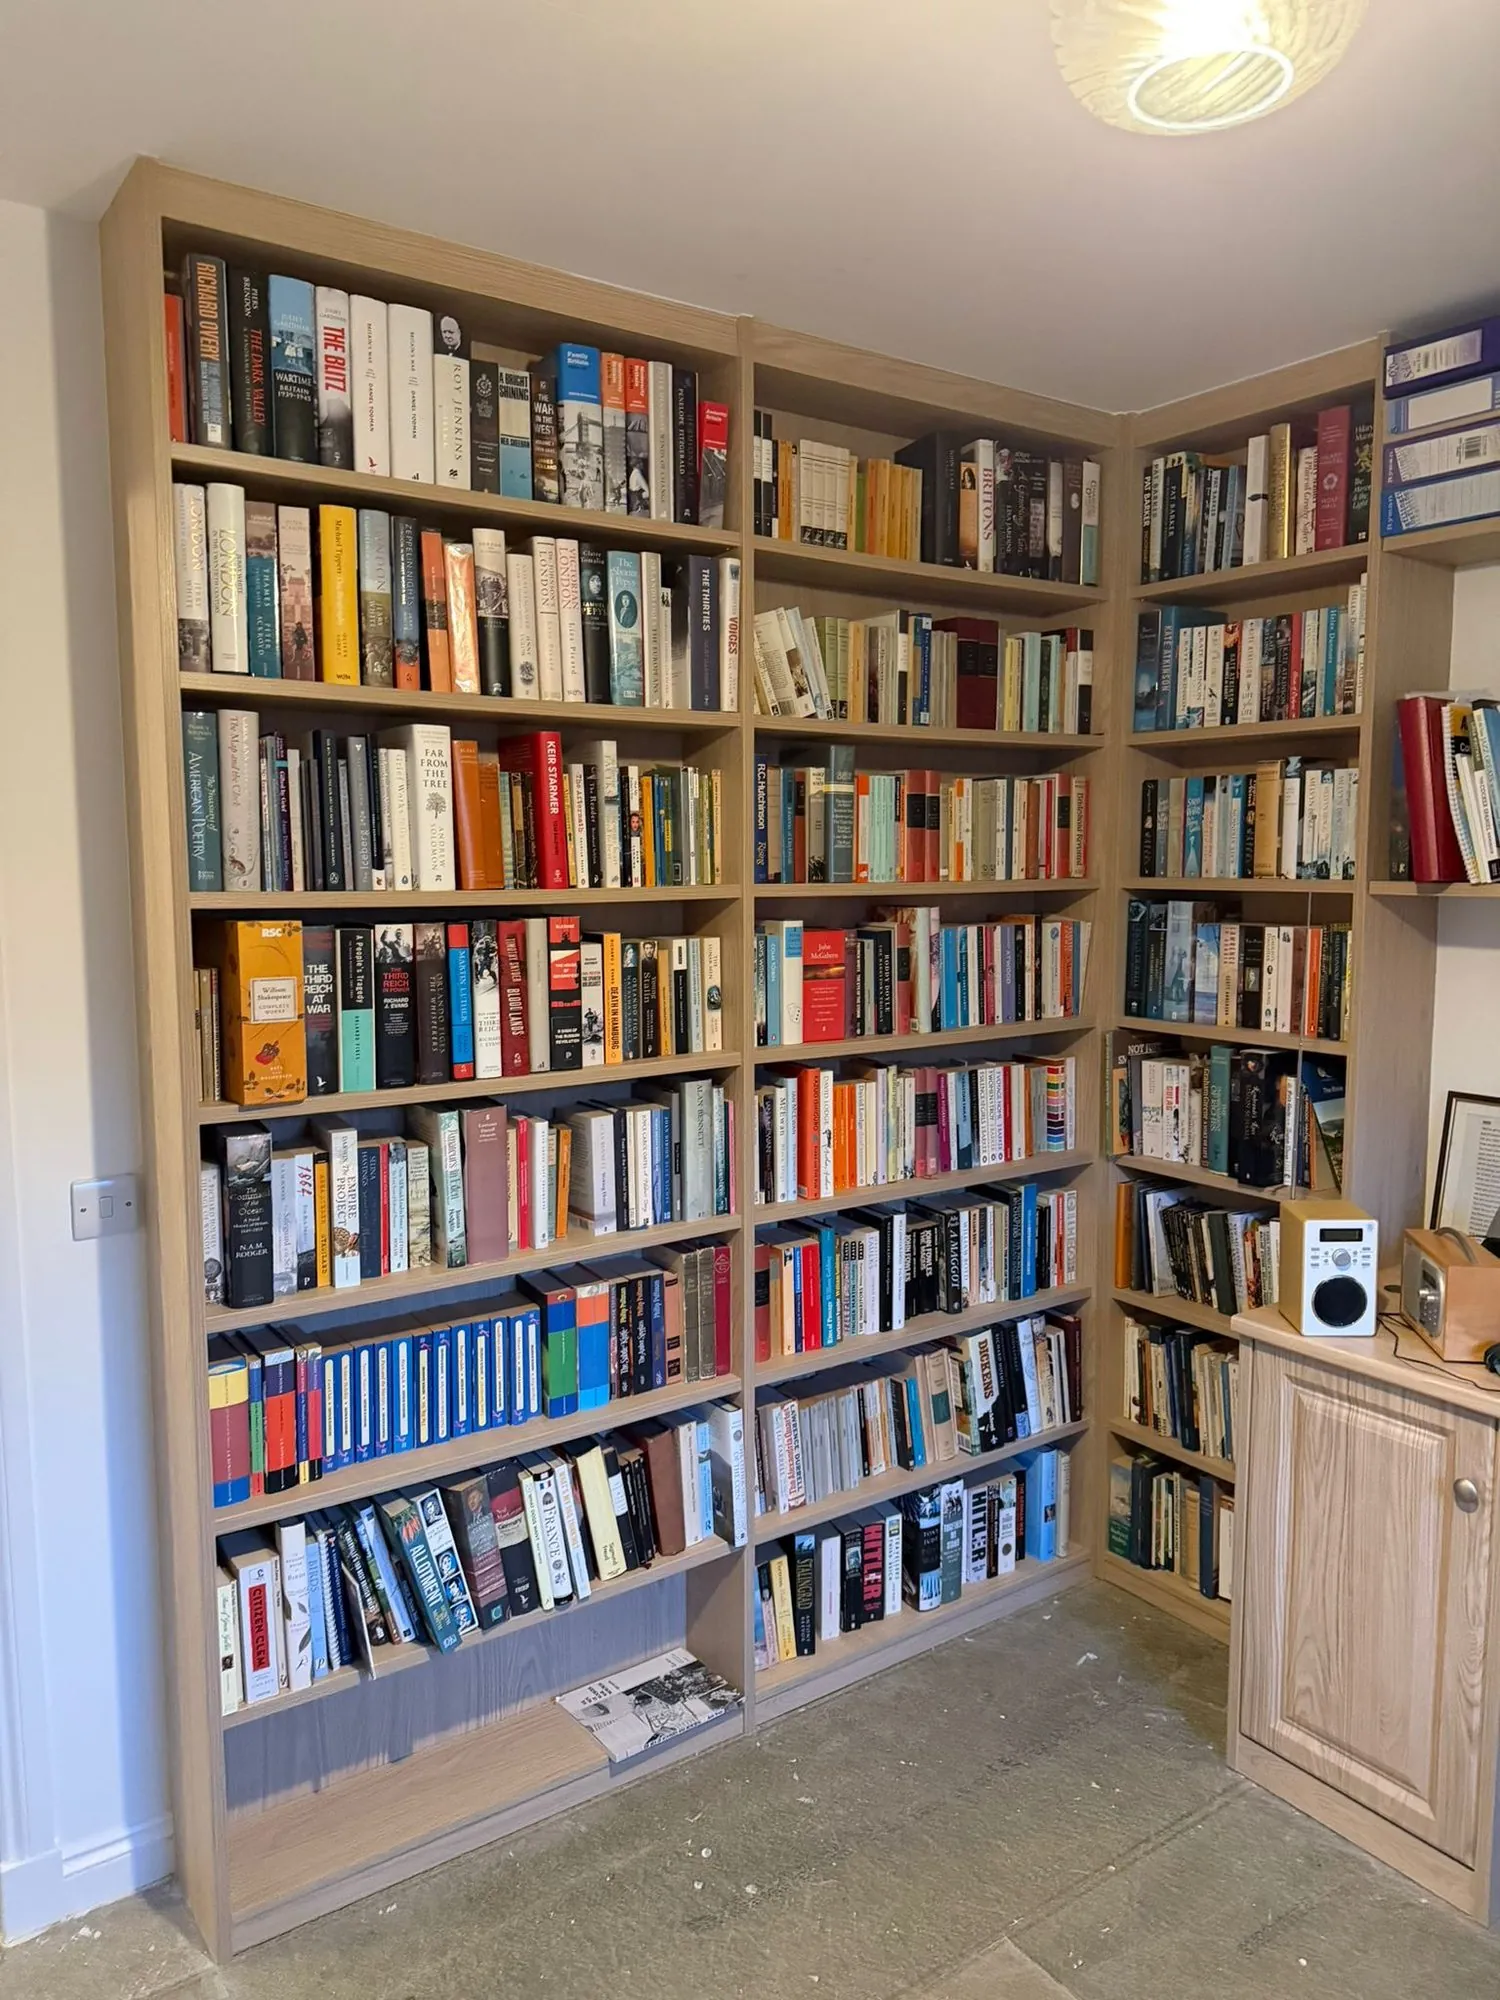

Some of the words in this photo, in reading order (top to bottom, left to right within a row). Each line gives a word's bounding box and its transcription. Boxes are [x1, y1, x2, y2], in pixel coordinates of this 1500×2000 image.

[197, 262, 218, 318] RICHARD
[199, 320, 220, 362] OVERY
[251, 329, 263, 350] THE
[323, 325, 345, 354] THE
[251, 352, 263, 384] DARK
[275, 371, 312, 387] WARTIME
[324, 355, 347, 393] BLITZ
[453, 364, 462, 395] ROY
[506, 373, 529, 388] BRIGHT
[253, 386, 265, 425] VALLEY
[499, 385, 529, 400] SHINING
[534, 402, 554, 415] WAR
[453, 397, 462, 462] JENKINS
[1142, 476, 1151, 491] PAT
[983, 467, 992, 540] BRITONS
[1142, 493, 1151, 527] BARKER
[405, 524, 413, 569] ZEPPELIN
[219, 529, 238, 617] LONDON
[539, 550, 550, 607] LONDON
[559, 547, 571, 609] LONDON
[702, 569, 710, 587] THE
[702, 588, 711, 631] THIRTIES
[256, 616, 264, 656] ACKROYD
[728, 616, 738, 654] VOICES
[1162, 625, 1172, 648] KATE
[1162, 651, 1172, 692] ATKINSON
[420, 758, 449, 768] FROM
[425, 748, 444, 758] FAR
[546, 741, 557, 764] KEIR
[189, 752, 206, 815] AMERICAN
[422, 779, 448, 789] TREE
[424, 769, 446, 779] THE
[548, 766, 559, 814] STARMER
[577, 791, 585, 832] Aftermath
[589, 796, 597, 822] Reader
[757, 781, 766, 830] Hutchinson
[191, 818, 207, 860] POETRY
[430, 823, 438, 870] SOLOMON
[438, 826, 446, 868] ANDREW
[262, 928, 283, 938] RSC
[307, 965, 328, 974] THE
[356, 941, 364, 972] People's
[458, 951, 466, 984] MARTIN
[303, 975, 333, 984] THIRD
[304, 985, 333, 994] REICH
[356, 974, 365, 1004] Tragedy
[382, 972, 409, 980] THIRD
[382, 979, 409, 988] REICH
[643, 972, 652, 1003] Stalin
[307, 1004, 331, 1014] WAR
[312, 994, 324, 1004] AT
[459, 988, 467, 1022] LUTHER
[610, 987, 618, 1007] DEATH
[611, 1017, 620, 1050] HAMBURG
[1202, 1068, 1210, 1096] Graham
[1202, 1097, 1210, 1120] Greene
[336, 1177, 346, 1226] PROJECT
[347, 1176, 356, 1219] EMPIRE
[950, 1230, 959, 1238] A
[235, 1249, 268, 1259] RODGER
[950, 1240, 959, 1281] MAGGOT
[620, 1308, 628, 1323] Philip
[653, 1302, 661, 1319] Philip
[978, 1338, 994, 1400] DICKENS
[790, 1404, 800, 1451] LAWRENCE
[795, 1453, 804, 1491] DURRELL
[498, 1517, 521, 1530] Germany
[544, 1506, 561, 1558] FRANCE
[972, 1490, 986, 1563] HITLER
[410, 1544, 443, 1607] ALLOTMENT
[864, 1524, 883, 1600] HITLER
[796, 1558, 813, 1610] STALINGRAD
[251, 1587, 264, 1635] CITIZEN
[253, 1636, 266, 1667] CLEM
